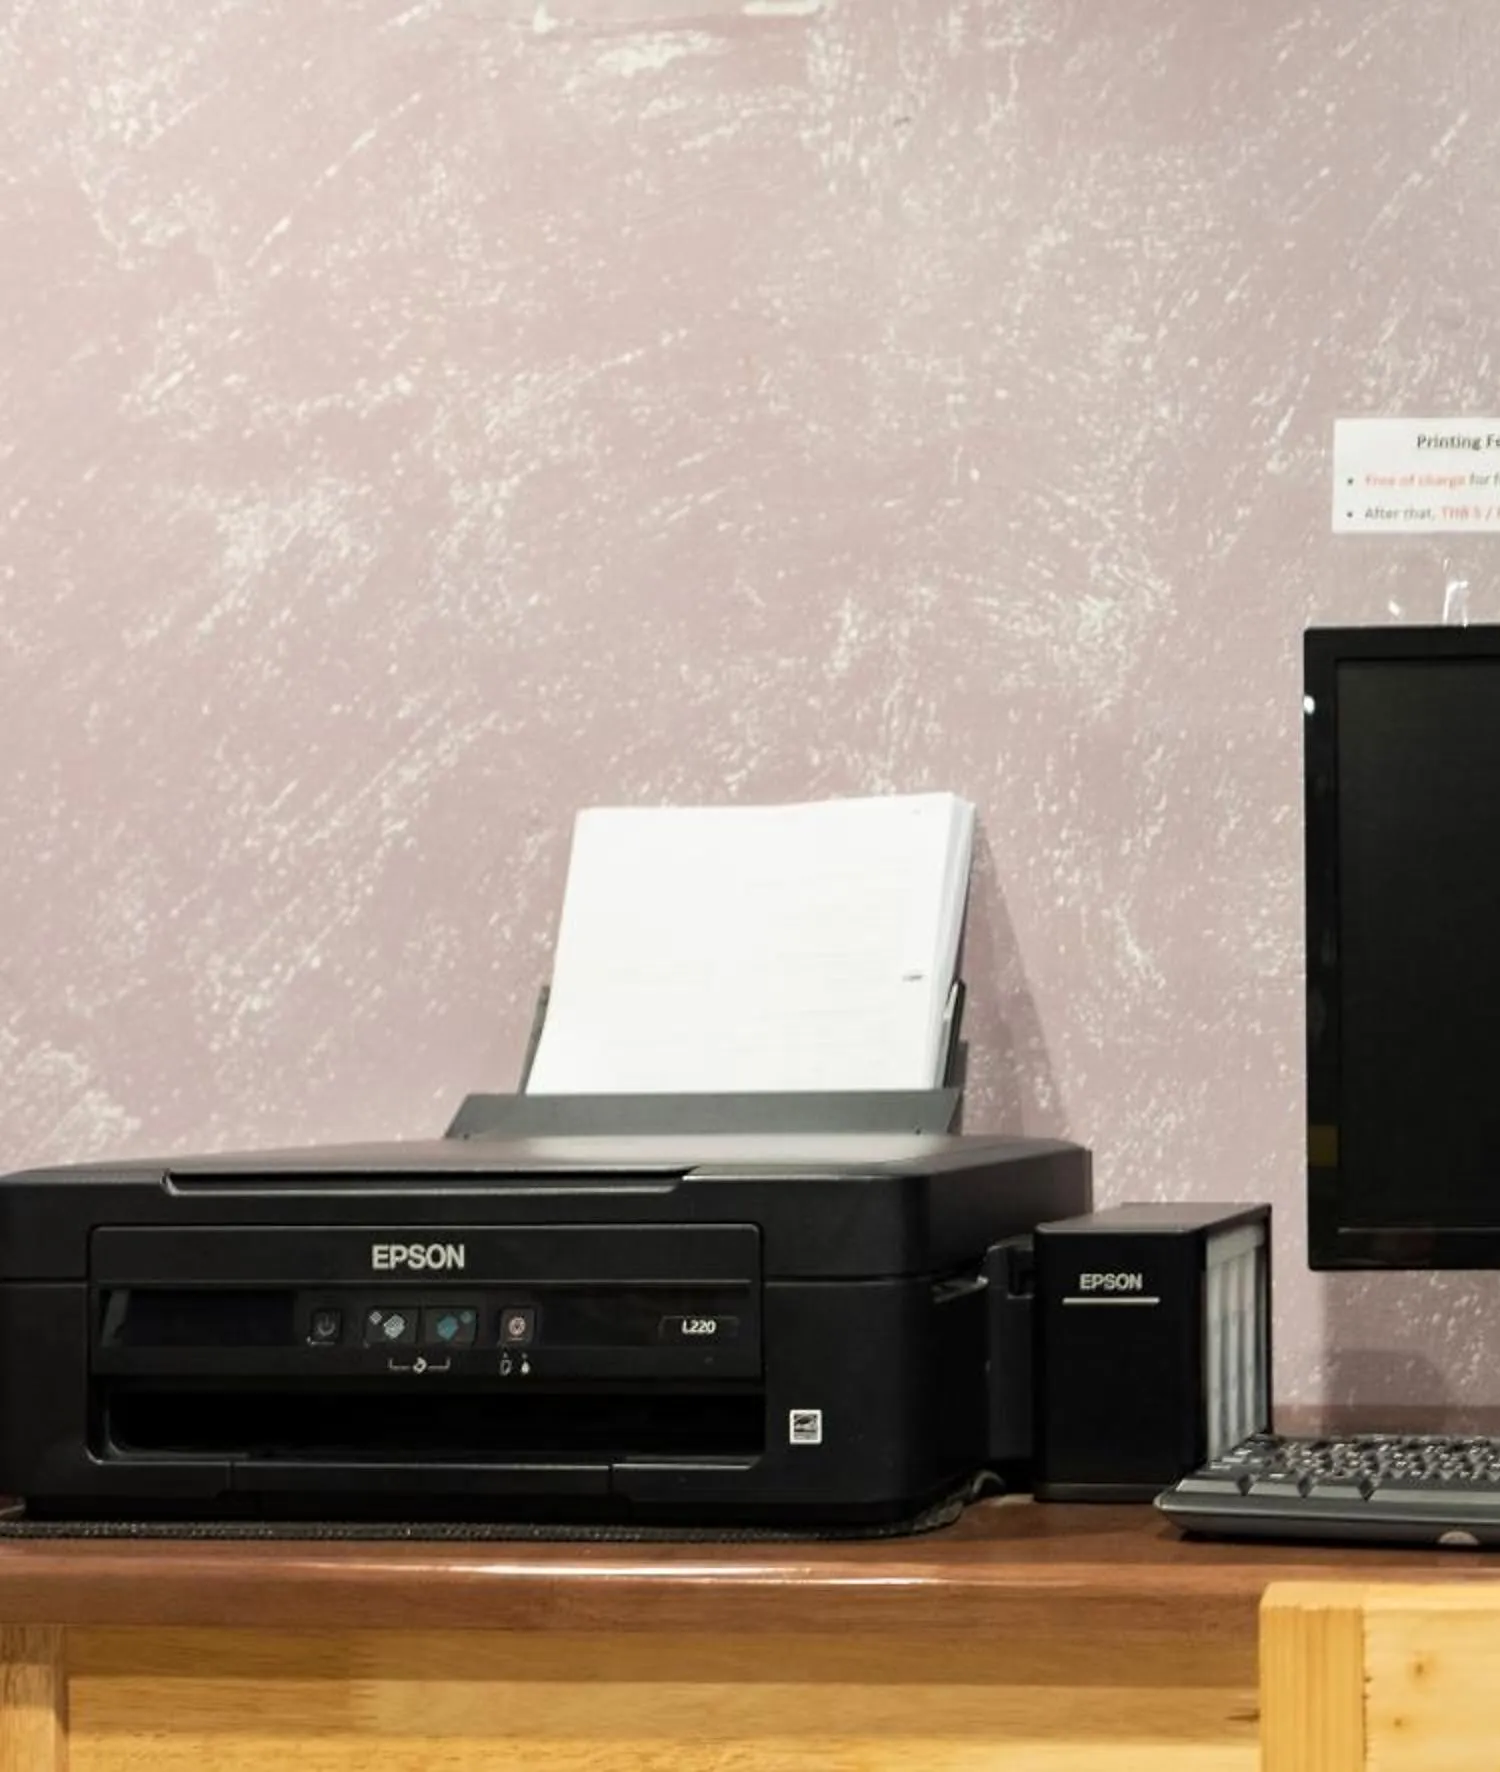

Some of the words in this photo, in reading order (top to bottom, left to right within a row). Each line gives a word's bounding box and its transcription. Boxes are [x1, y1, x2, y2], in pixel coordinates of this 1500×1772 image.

[1417, 434, 1481, 450] Printing
[1365, 474, 1396, 486] Free
[1399, 474, 1415, 486] of
[1418, 474, 1466, 489] charge
[1469, 472, 1490, 486] for
[1364, 507, 1398, 520] After
[371, 1244, 466, 1270] EPSON
[1079, 1273, 1143, 1291] EPSON
[681, 1319, 717, 1335] L220
